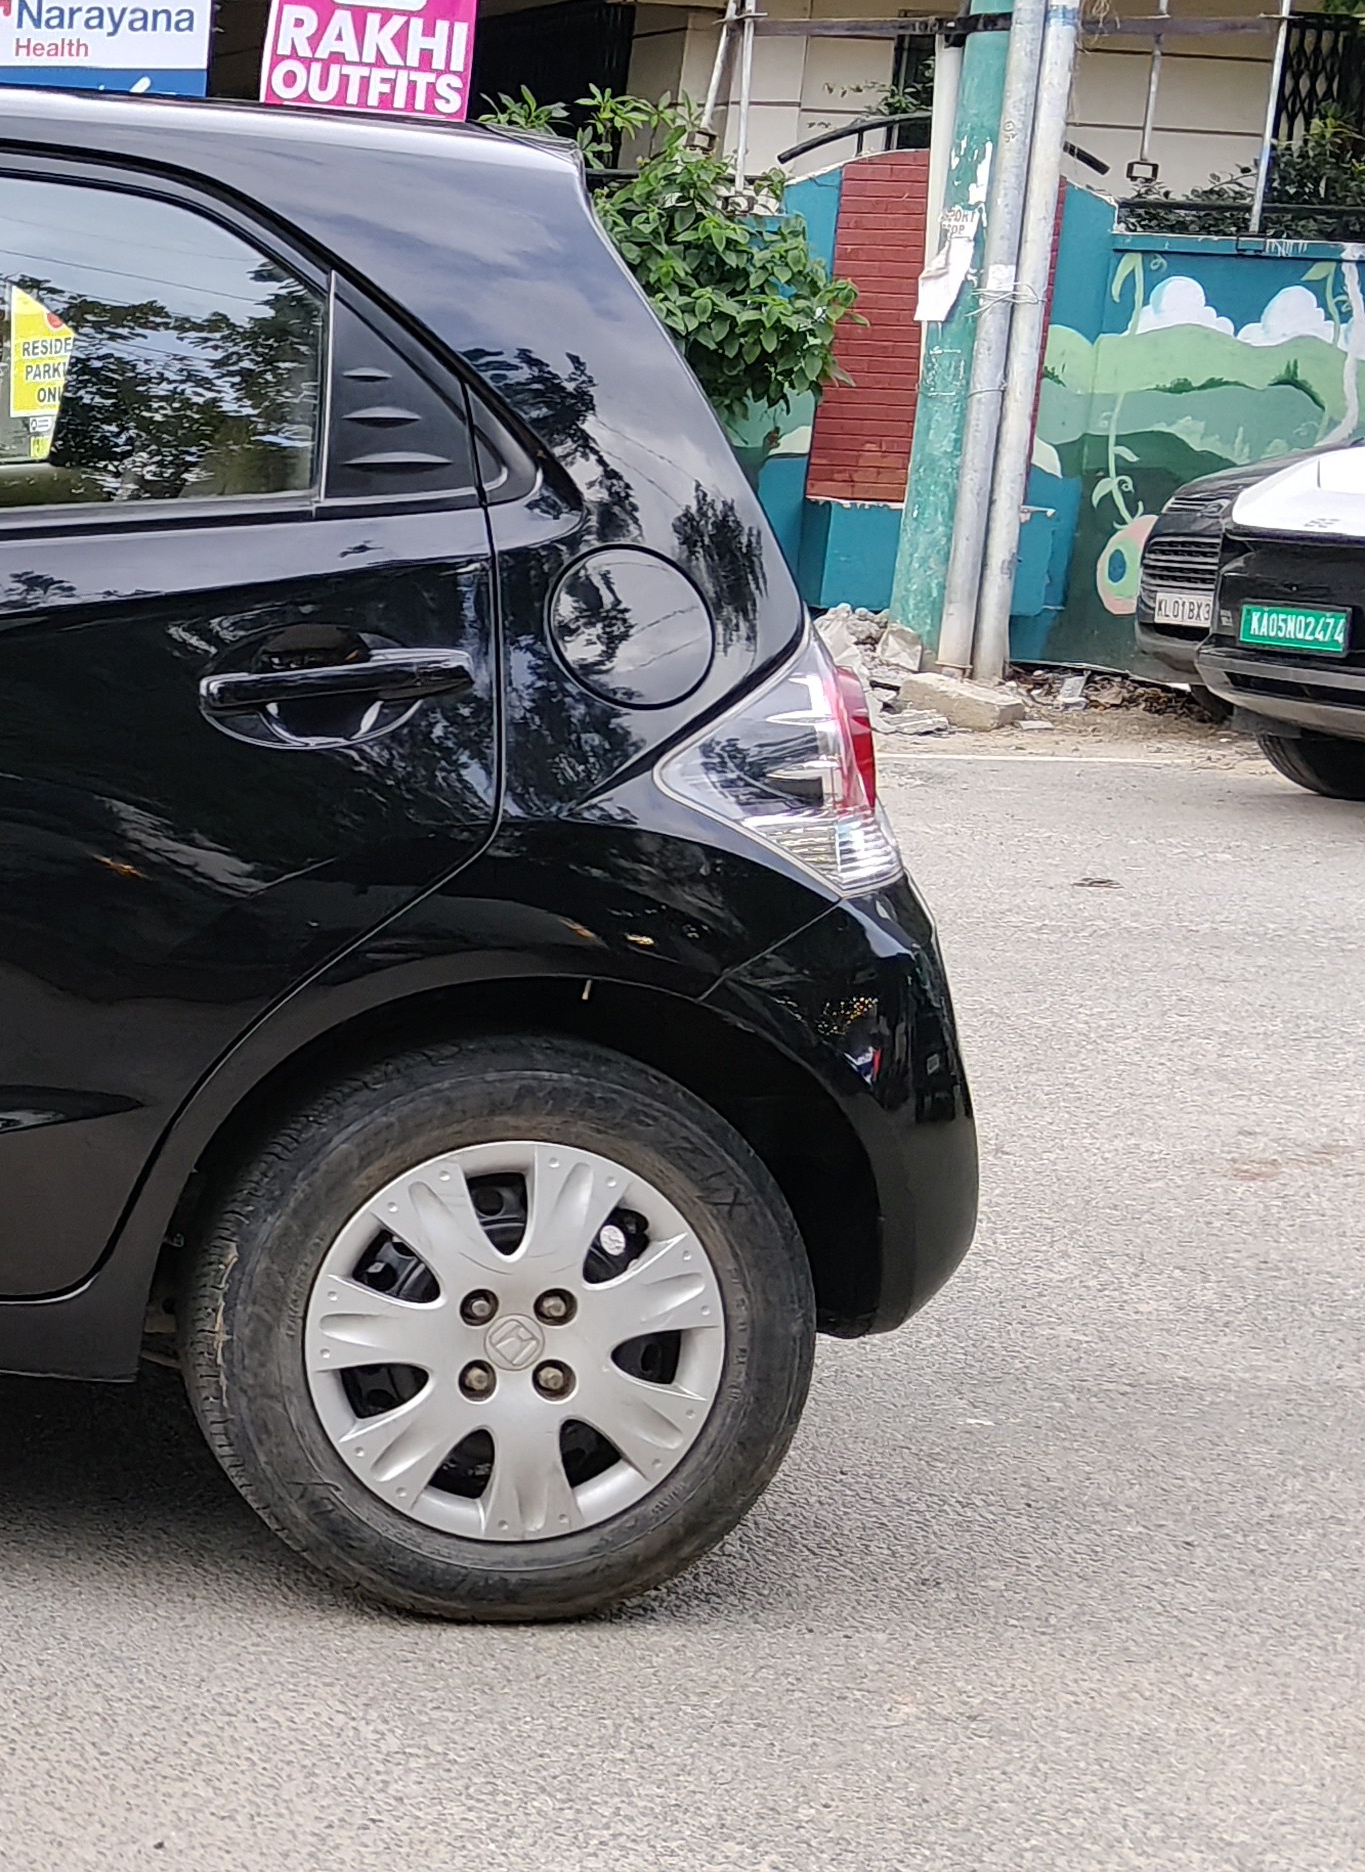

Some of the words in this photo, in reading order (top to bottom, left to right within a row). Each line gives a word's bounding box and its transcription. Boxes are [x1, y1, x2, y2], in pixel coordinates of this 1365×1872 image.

[16, 0, 195, 37] Narayana
[276, 4, 469, 72] RAKHI
[14, 37, 89, 57] Health
[271, 59, 464, 114] OUTFITS
